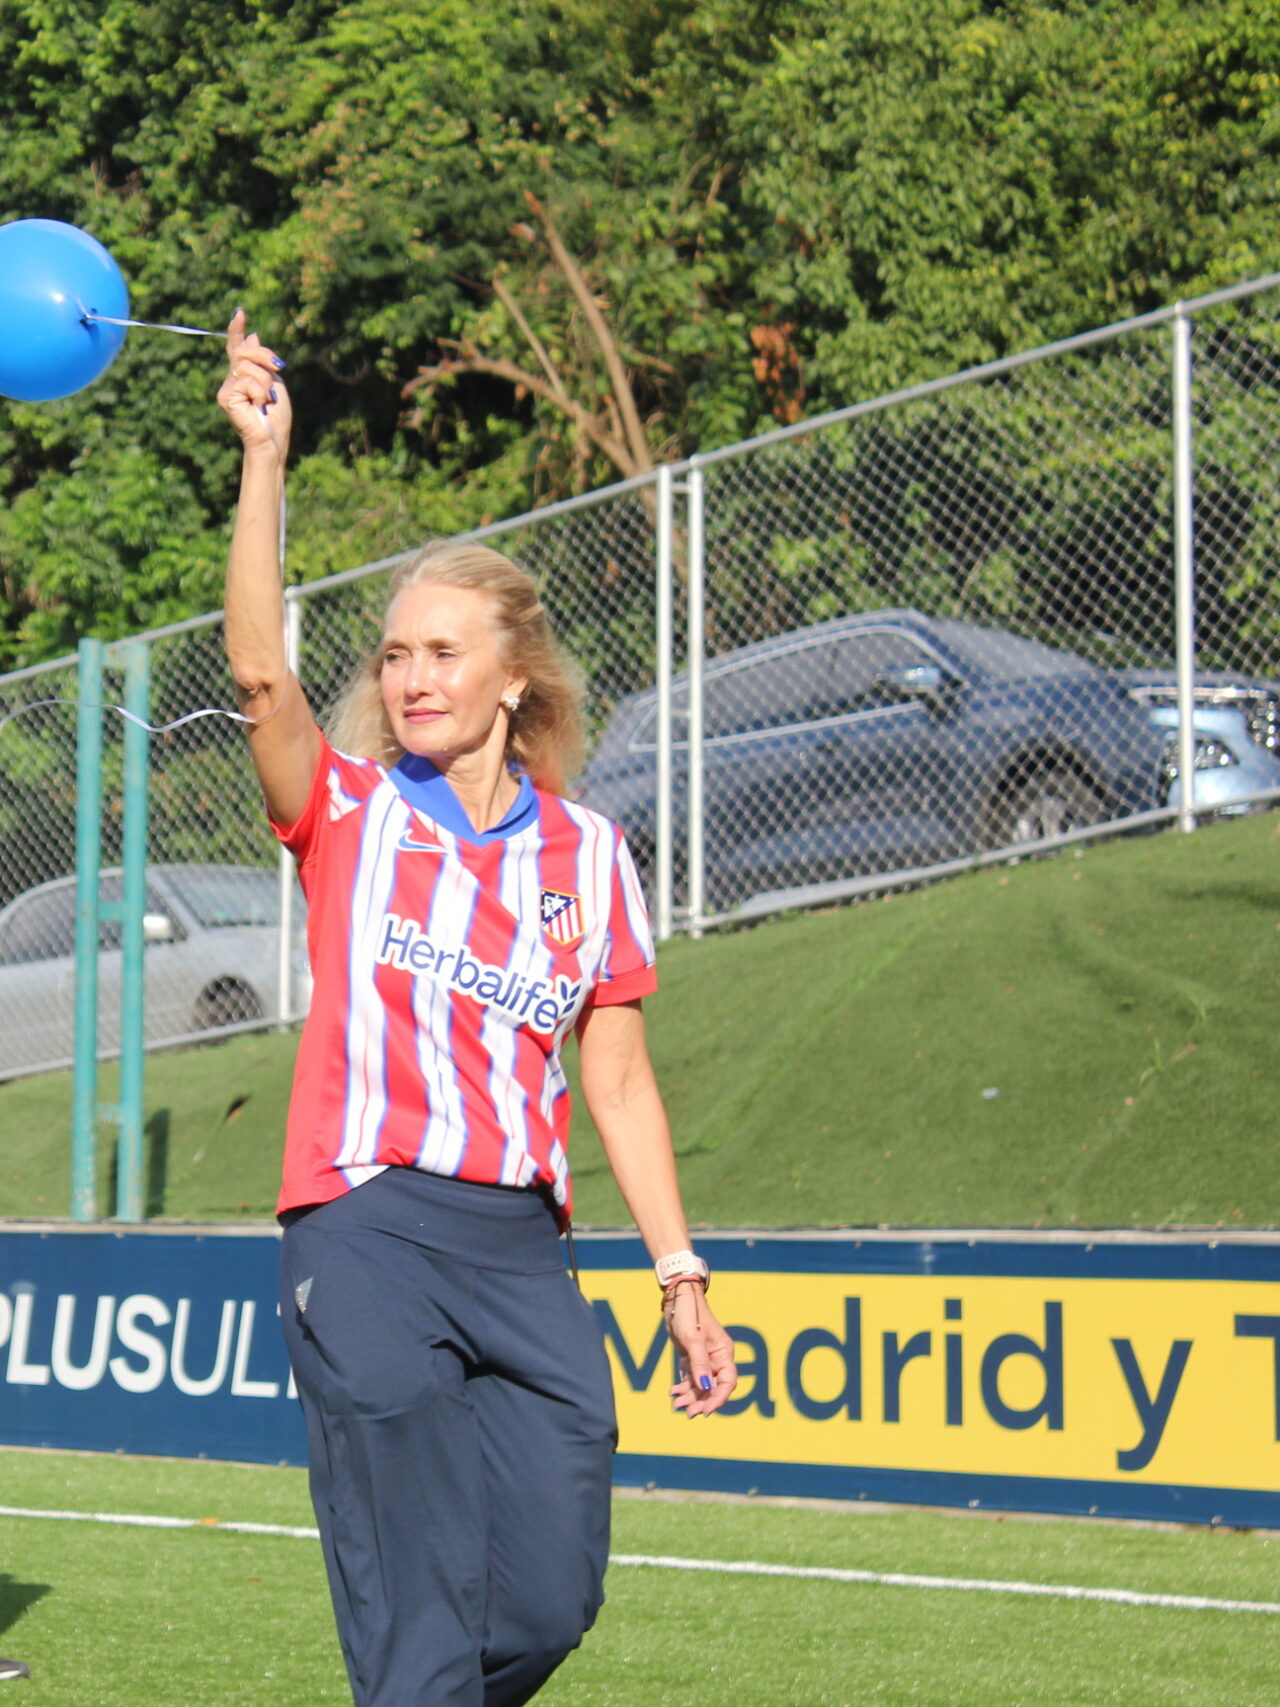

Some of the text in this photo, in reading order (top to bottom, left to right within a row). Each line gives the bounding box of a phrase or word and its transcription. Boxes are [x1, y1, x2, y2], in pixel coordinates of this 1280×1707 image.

[380, 920, 560, 1029] Herbalife
[590, 1295, 1066, 1433] Madrid
[1109, 1337, 1196, 1472] y
